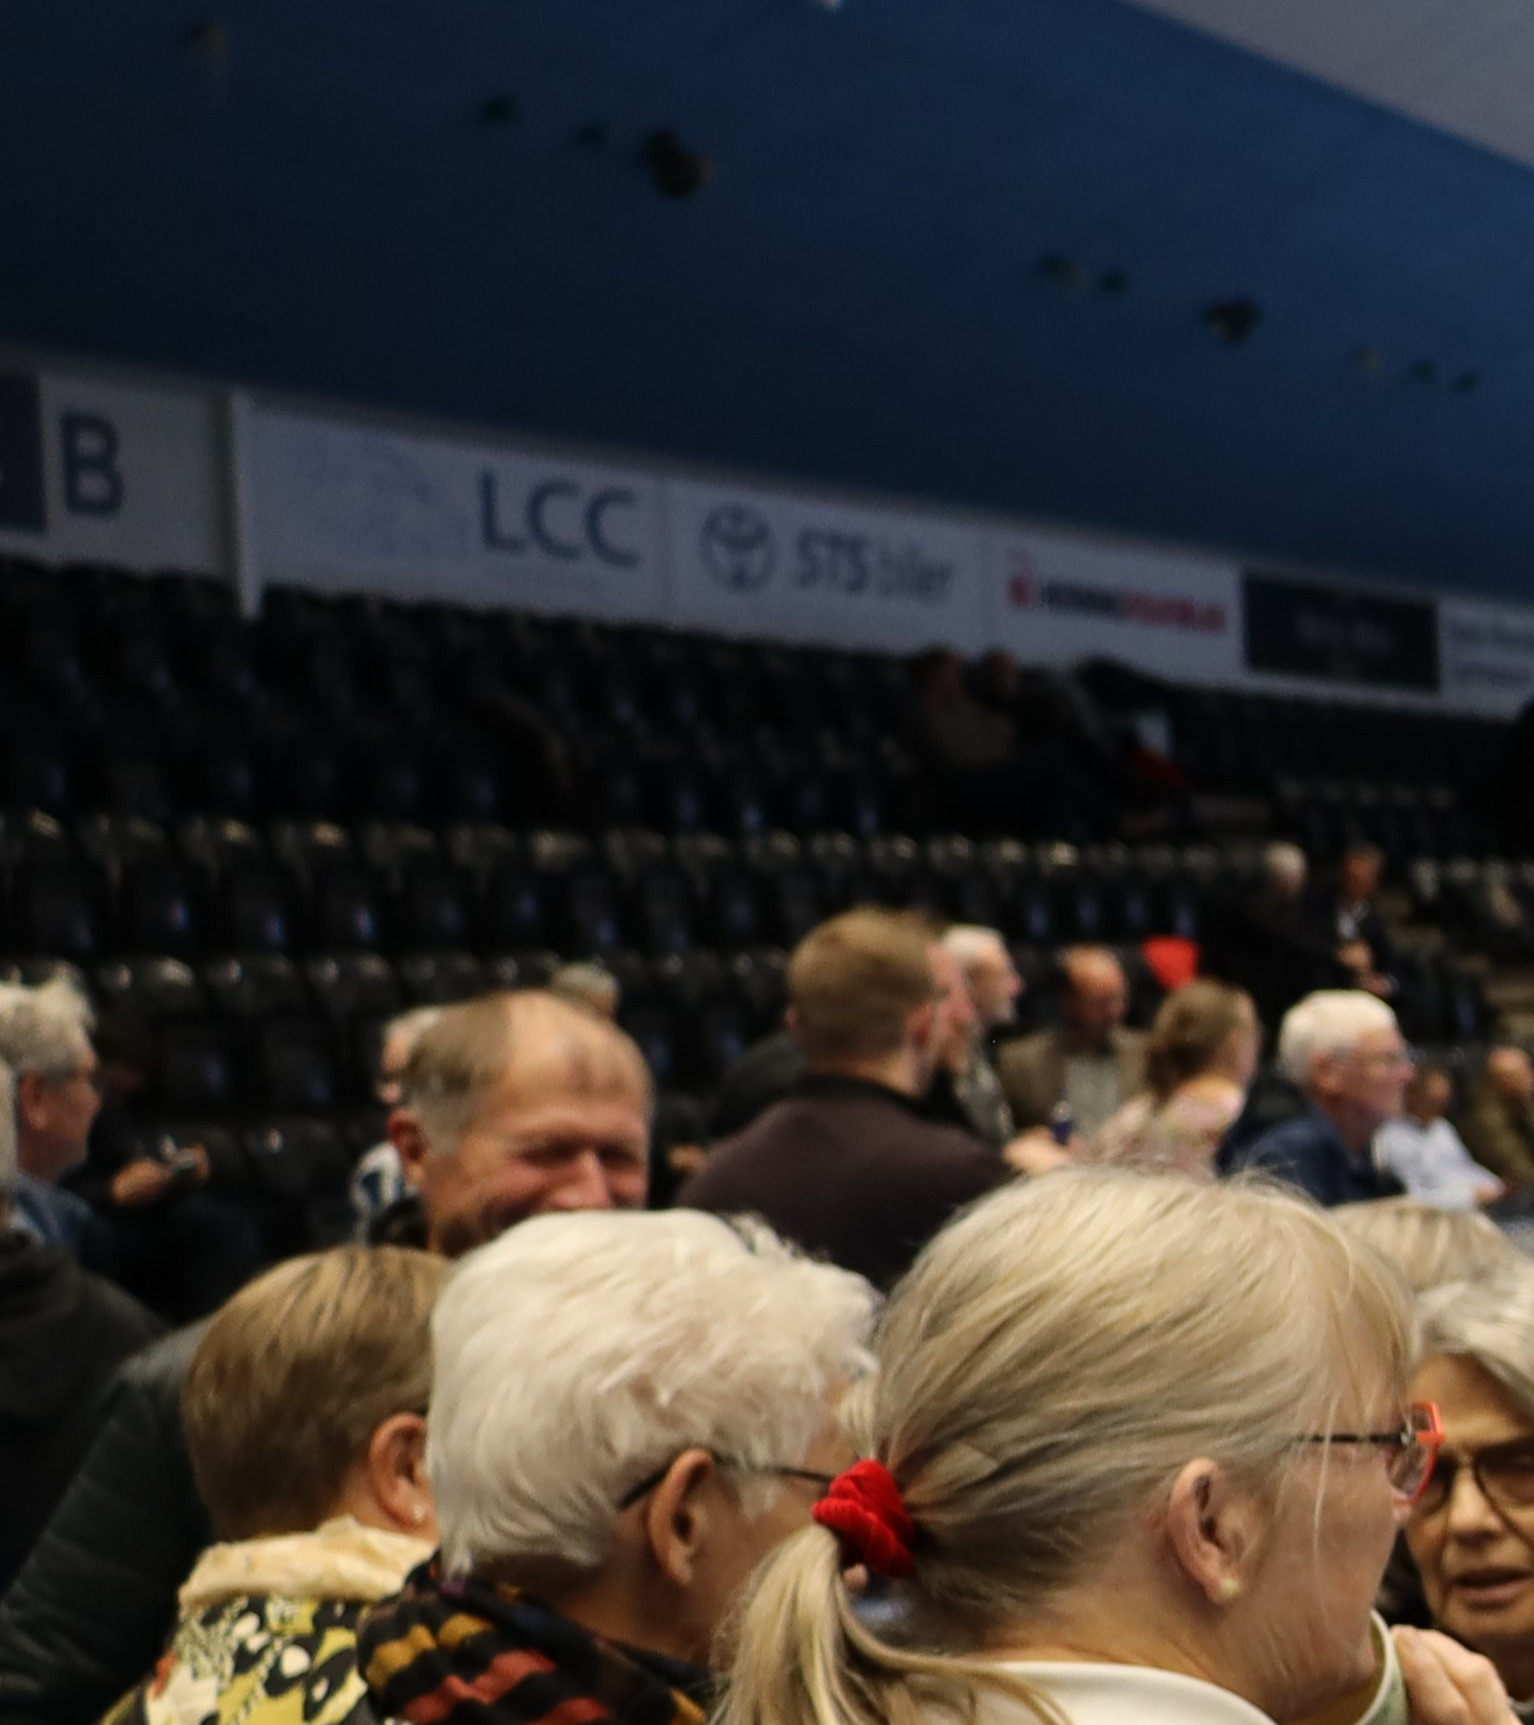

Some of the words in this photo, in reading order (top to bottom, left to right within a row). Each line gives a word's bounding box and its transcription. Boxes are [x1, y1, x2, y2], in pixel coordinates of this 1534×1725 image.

[60, 408, 126, 518] B
[477, 468, 643, 572] LCC
[792, 528, 872, 599] STS
